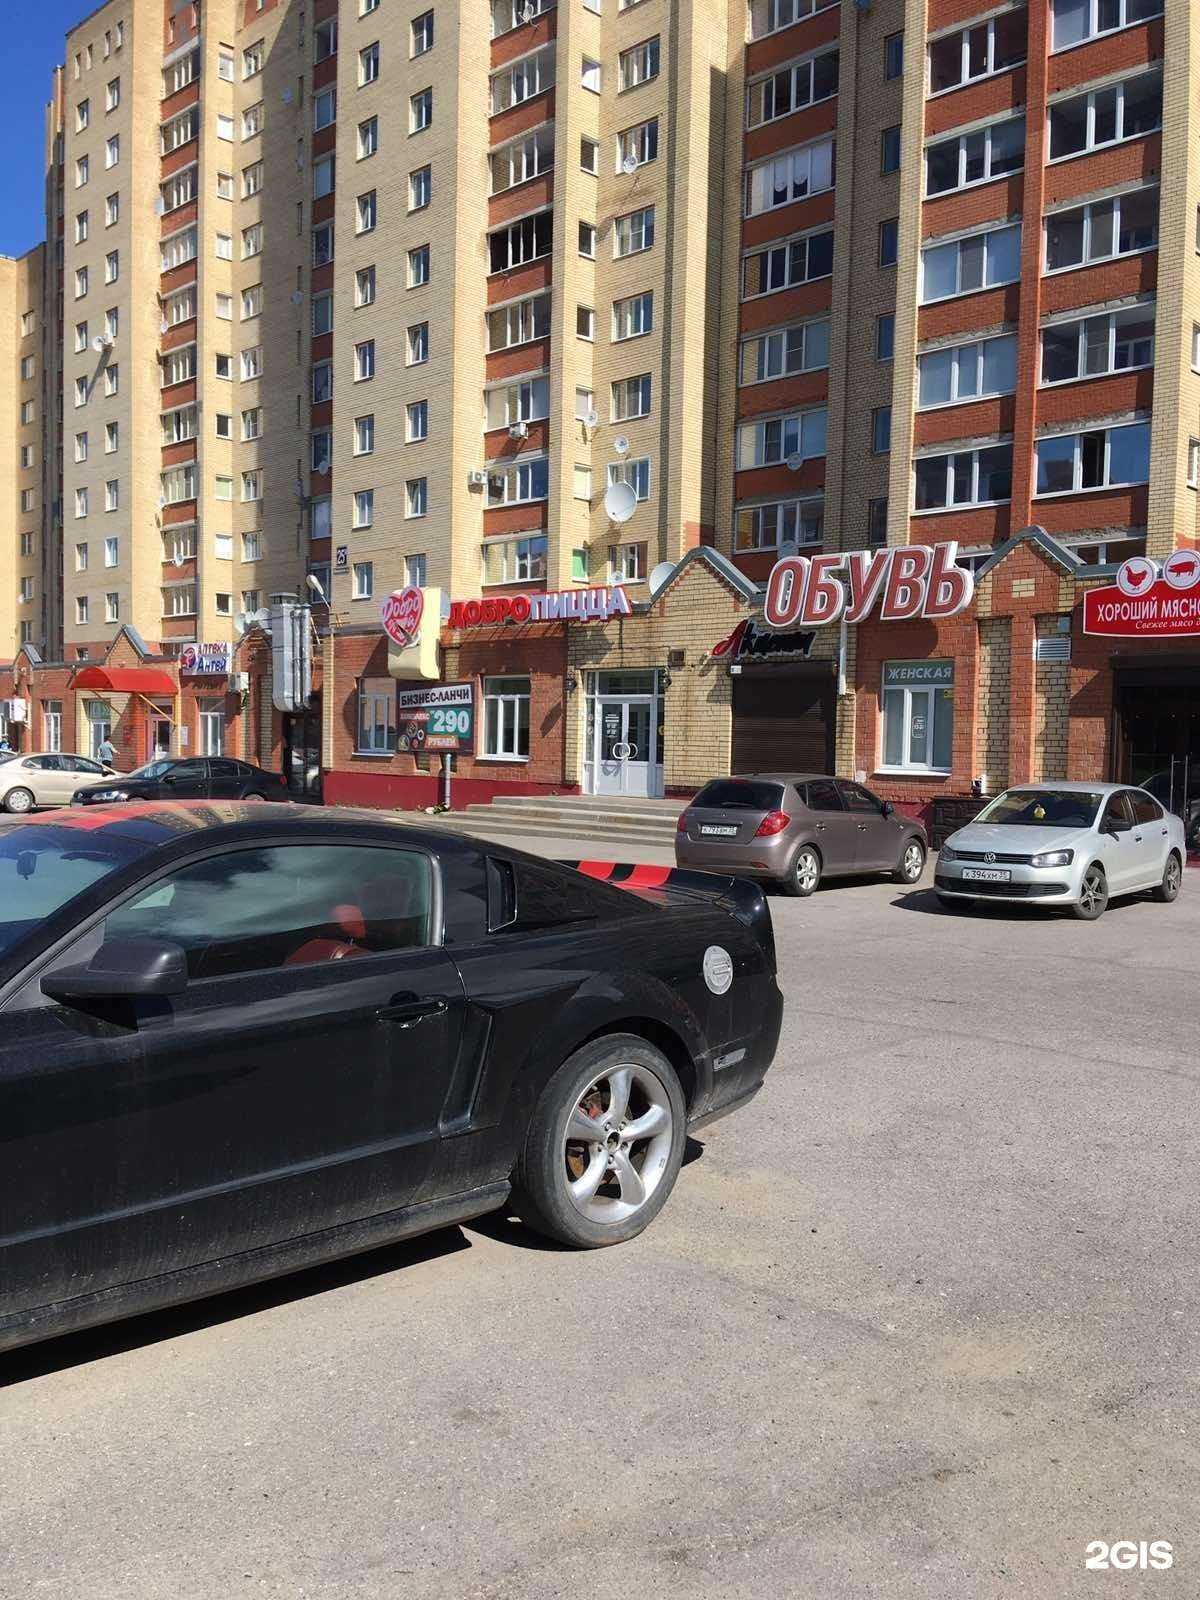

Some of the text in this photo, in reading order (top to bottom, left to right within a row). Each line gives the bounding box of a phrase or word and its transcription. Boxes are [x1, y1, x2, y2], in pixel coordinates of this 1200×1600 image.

[764, 541, 974, 627] ОБУВЬ
[1097, 596, 1158, 622] ХОРОШИЙ
[1136, 620, 1168, 629] Свежее
[1169, 619, 1193, 628] мясо
[888, 667, 952, 680] ЖЕНСКАЯ
[401, 688, 470, 706] БИЗНЕС-ЛАНЧИ
[433, 710, 470, 733] 290
